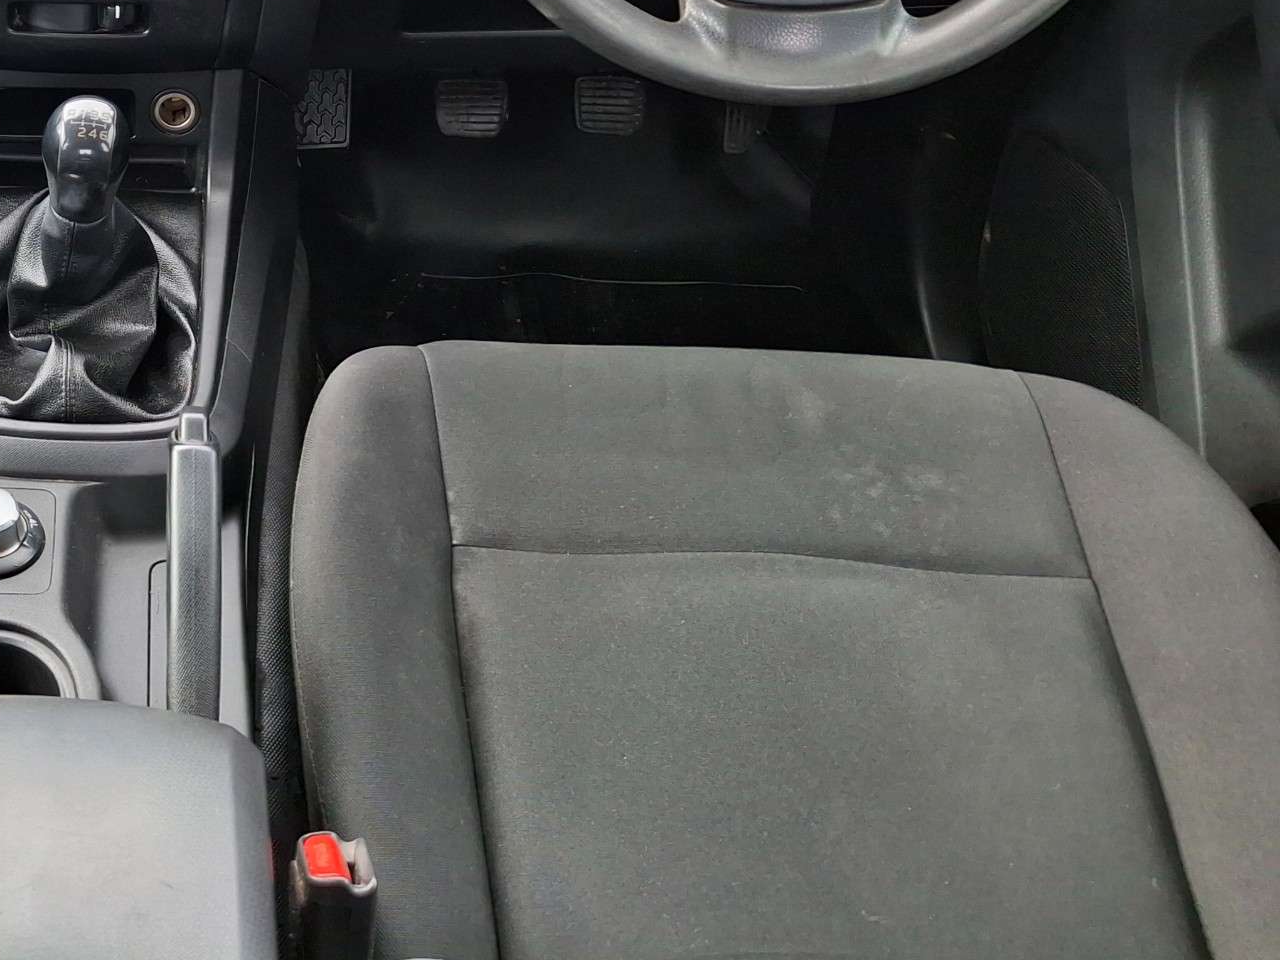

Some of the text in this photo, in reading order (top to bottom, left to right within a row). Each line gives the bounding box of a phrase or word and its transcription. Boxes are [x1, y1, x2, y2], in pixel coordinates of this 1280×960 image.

[77, 126, 108, 141] 2 4 6
